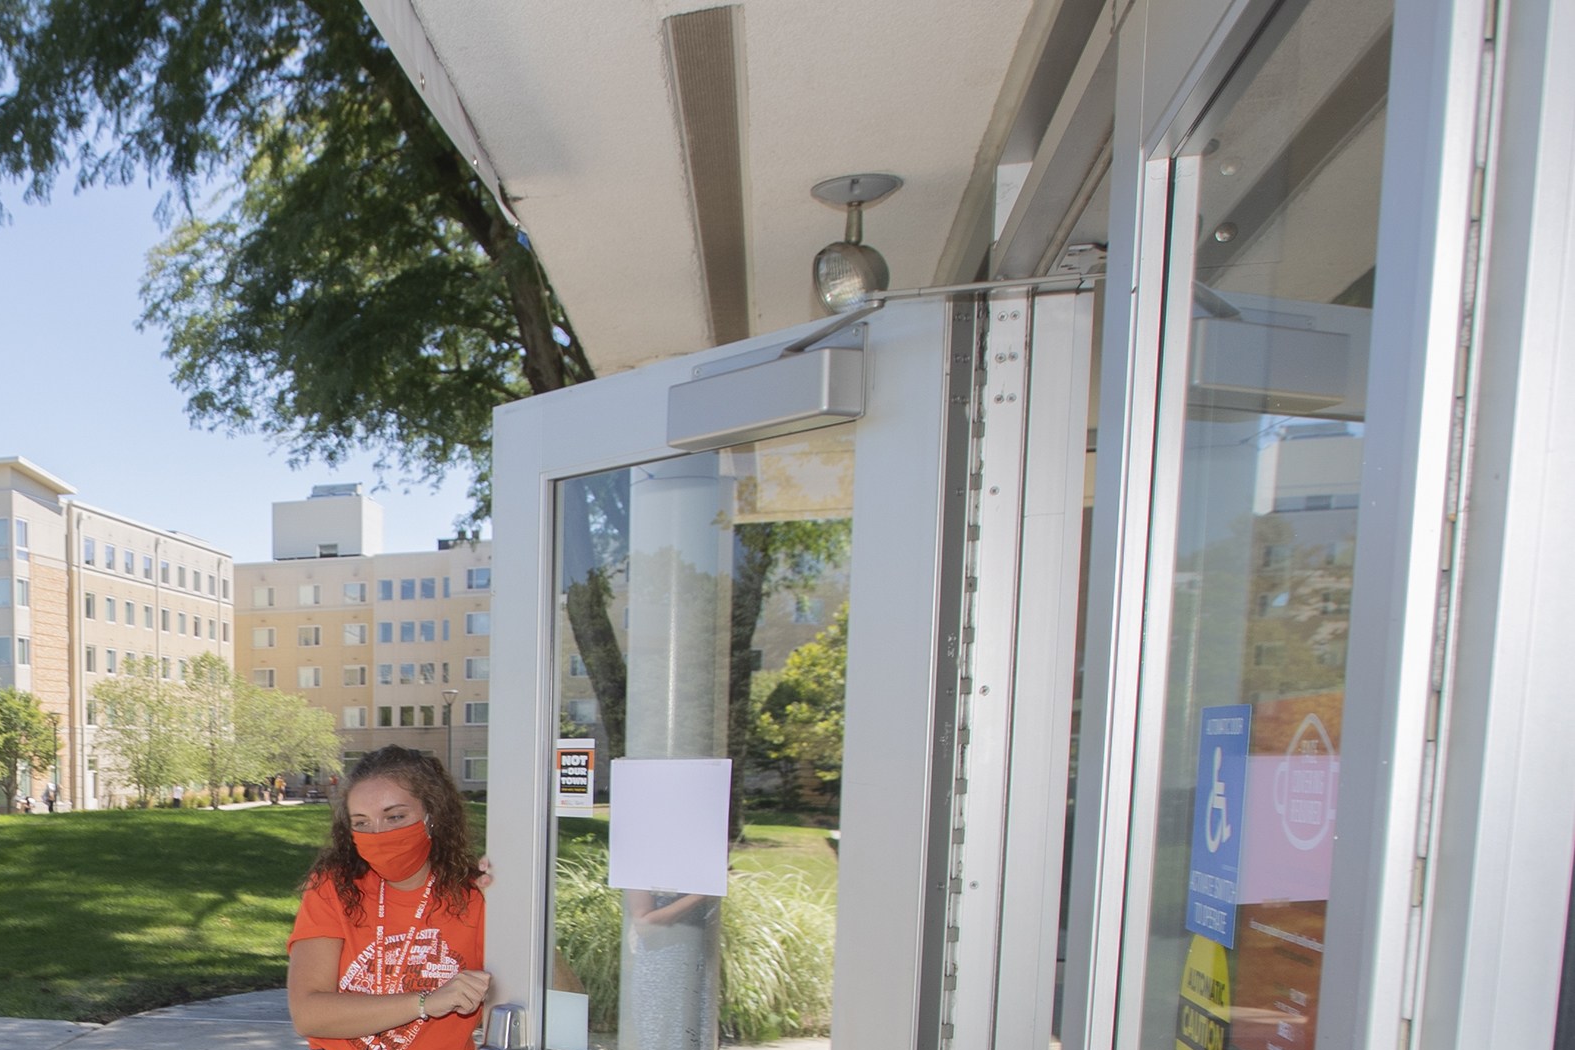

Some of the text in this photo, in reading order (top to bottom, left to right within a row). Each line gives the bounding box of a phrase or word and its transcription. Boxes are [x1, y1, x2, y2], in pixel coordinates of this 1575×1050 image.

[561, 754, 588, 766] NOT
[567, 767, 587, 776] OUR
[561, 776, 587, 785] TOWN
[426, 961, 459, 972] Opening
[1188, 967, 1226, 1006] AUTOMATIC
